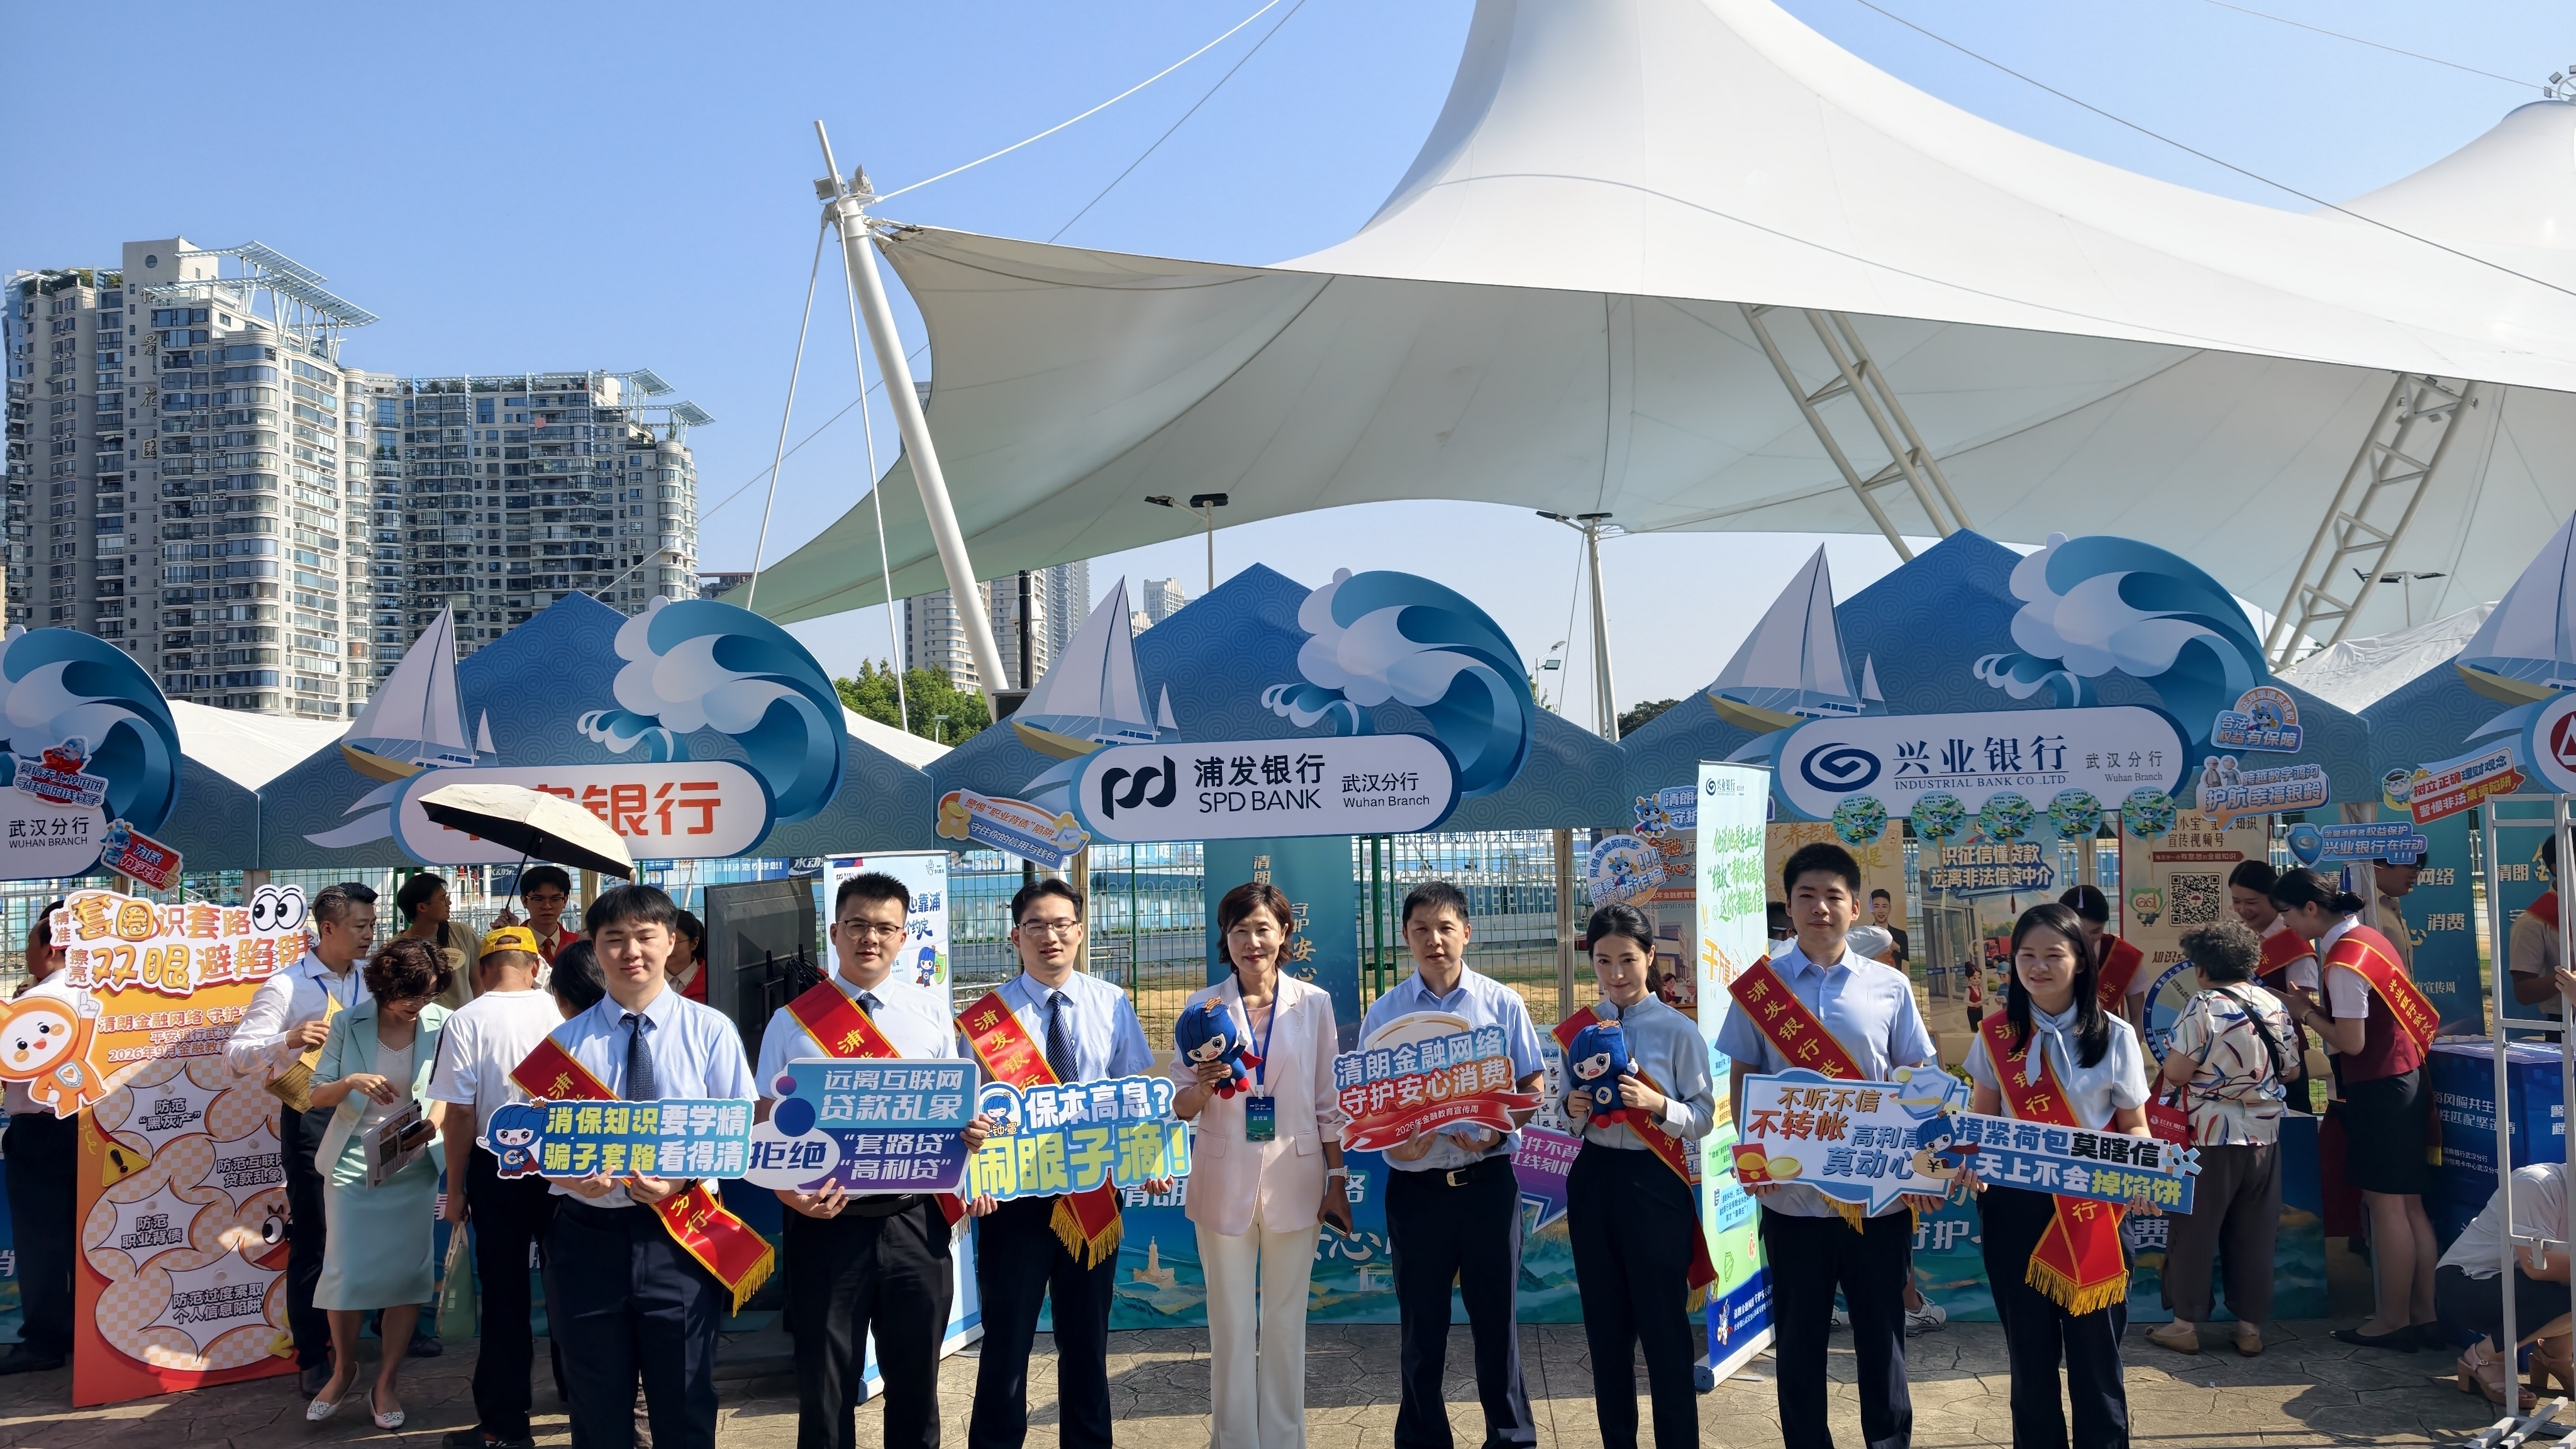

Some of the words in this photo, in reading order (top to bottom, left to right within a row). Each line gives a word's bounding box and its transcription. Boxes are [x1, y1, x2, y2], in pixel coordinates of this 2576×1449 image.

[2221, 716, 2250, 730] 合法
[2218, 730, 2297, 747] 权益有保障
[1893, 736, 2067, 775] 兴业银行
[2086, 751, 2163, 769] 武汉分行
[1194, 753, 1324, 787] 浦发银行
[2105, 772, 2133, 783] Wuhan
[2135, 771, 2163, 782] Branch
[2243, 765, 2319, 786] 跨越数字鸿沟
[2412, 755, 2507, 797] 树立正确理财观念
[1342, 772, 1419, 792] 武汉分行
[1718, 779, 1735, 791] 兴业银行
[1895, 778, 1972, 790] INDUSTRIAL
[1977, 777, 2012, 788] BANK
[1199, 791, 1246, 813] SPD
[1253, 788, 1321, 811] BANK
[1343, 796, 1385, 808] Wuhan
[1387, 794, 1430, 806] Branch
[1665, 791, 1697, 807] 清朗
[2206, 782, 2322, 813] 护航幸福银龄
[9, 817, 89, 838] 武汉分行
[2324, 826, 2407, 838] 金融消费者权益保护
[9, 839, 45, 848] WUHAN
[48, 836, 87, 847] BRANCH
[970, 822, 1057, 861] 守住你的信用与钱包
[1712, 824, 1762, 856] 他说他是专业的
[2168, 833, 2224, 848] 宣传视频号
[2324, 838, 2423, 855] 兴业银行在行动
[133, 843, 163, 865] 为民
[1942, 844, 2040, 866] 识征信懂贷款
[120, 853, 167, 884] 办实事
[1930, 866, 2053, 889] 远离非法信贷中介
[2417, 868, 2455, 886] 网络
[54, 911, 70, 942] 精准
[71, 894, 251, 942] 套圈识套路
[2428, 913, 2465, 931] 消费
[69, 948, 89, 983] 擦亮
[91, 930, 313, 990] 双眼避陷阱
[99, 1010, 203, 1032] 清朗金融网络
[207, 1006, 248, 1023] 守护
[150, 1024, 237, 1044] 平安银行武汉
[1336, 1029, 1504, 1087] 清朗金融网络
[824, 1069, 964, 1092] 远离互联网
[1341, 1058, 1509, 1114] 守护安心消费
[155, 1098, 187, 1114] 防范
[819, 1093, 963, 1122] 贷款乱象
[1777, 1087, 1882, 1113] 不听不信
[138, 1111, 201, 1131] “黑灰产”
[545, 1106, 747, 1136] 消保知识要学精
[1395, 1105, 1479, 1136] 2026年金融教育宣传周
[1747, 1109, 1848, 1141] 不转帐
[843, 1133, 955, 1156] “套路贷”
[1955, 1116, 2160, 1169] 捂紧荷包莫瞎信
[543, 1140, 743, 1172] 骗子套路看得清
[749, 1141, 826, 1170] 拒绝
[1823, 1147, 1914, 1180] 莫动心
[224, 1169, 282, 1188] 贷款乱象
[840, 1158, 952, 1181] “高利贷”
[1976, 1153, 2182, 1206] 天上不会掉馅饼
[136, 1214, 168, 1232] 防范
[670, 1195, 709, 1235] 分行
[2072, 1202, 2097, 1222] 行
[121, 1230, 182, 1249] 职业背债
[1913, 1221, 1981, 1250] 守护
[172, 1284, 263, 1309] 防范过度索取
[172, 1299, 262, 1323] 个人信息陷阱
